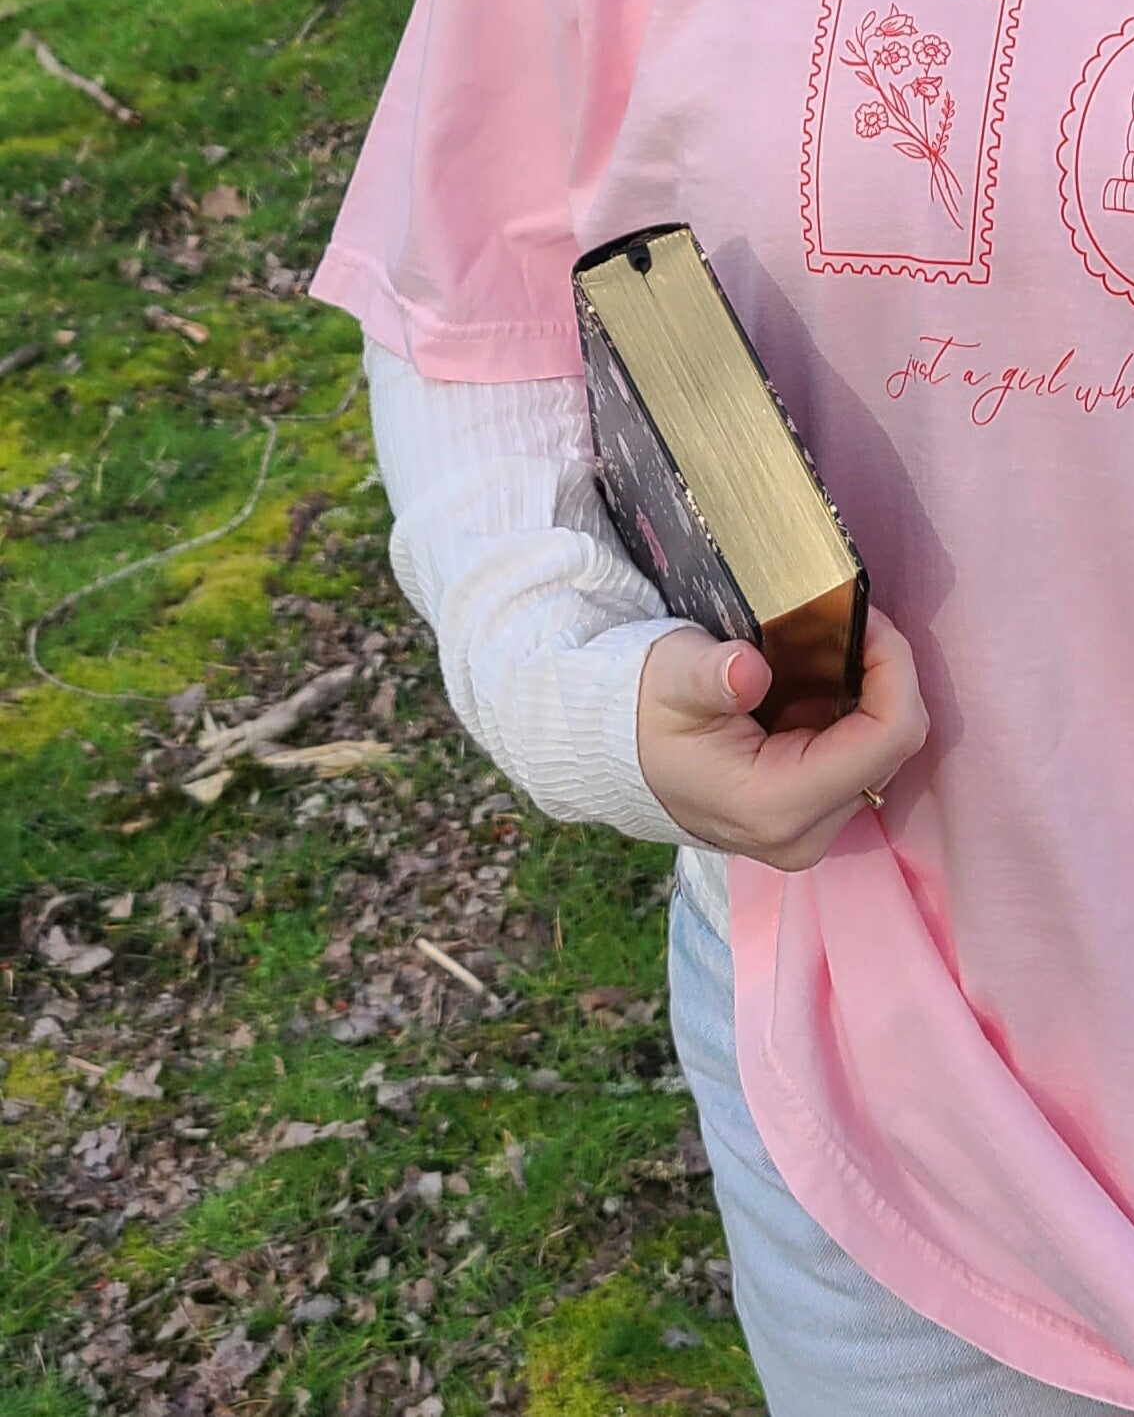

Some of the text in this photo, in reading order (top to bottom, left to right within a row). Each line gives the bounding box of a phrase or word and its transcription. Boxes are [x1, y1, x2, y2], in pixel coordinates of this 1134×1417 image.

[886, 336, 981, 399] just
[962, 369, 993, 388] a
[972, 348, 1075, 426] girl
